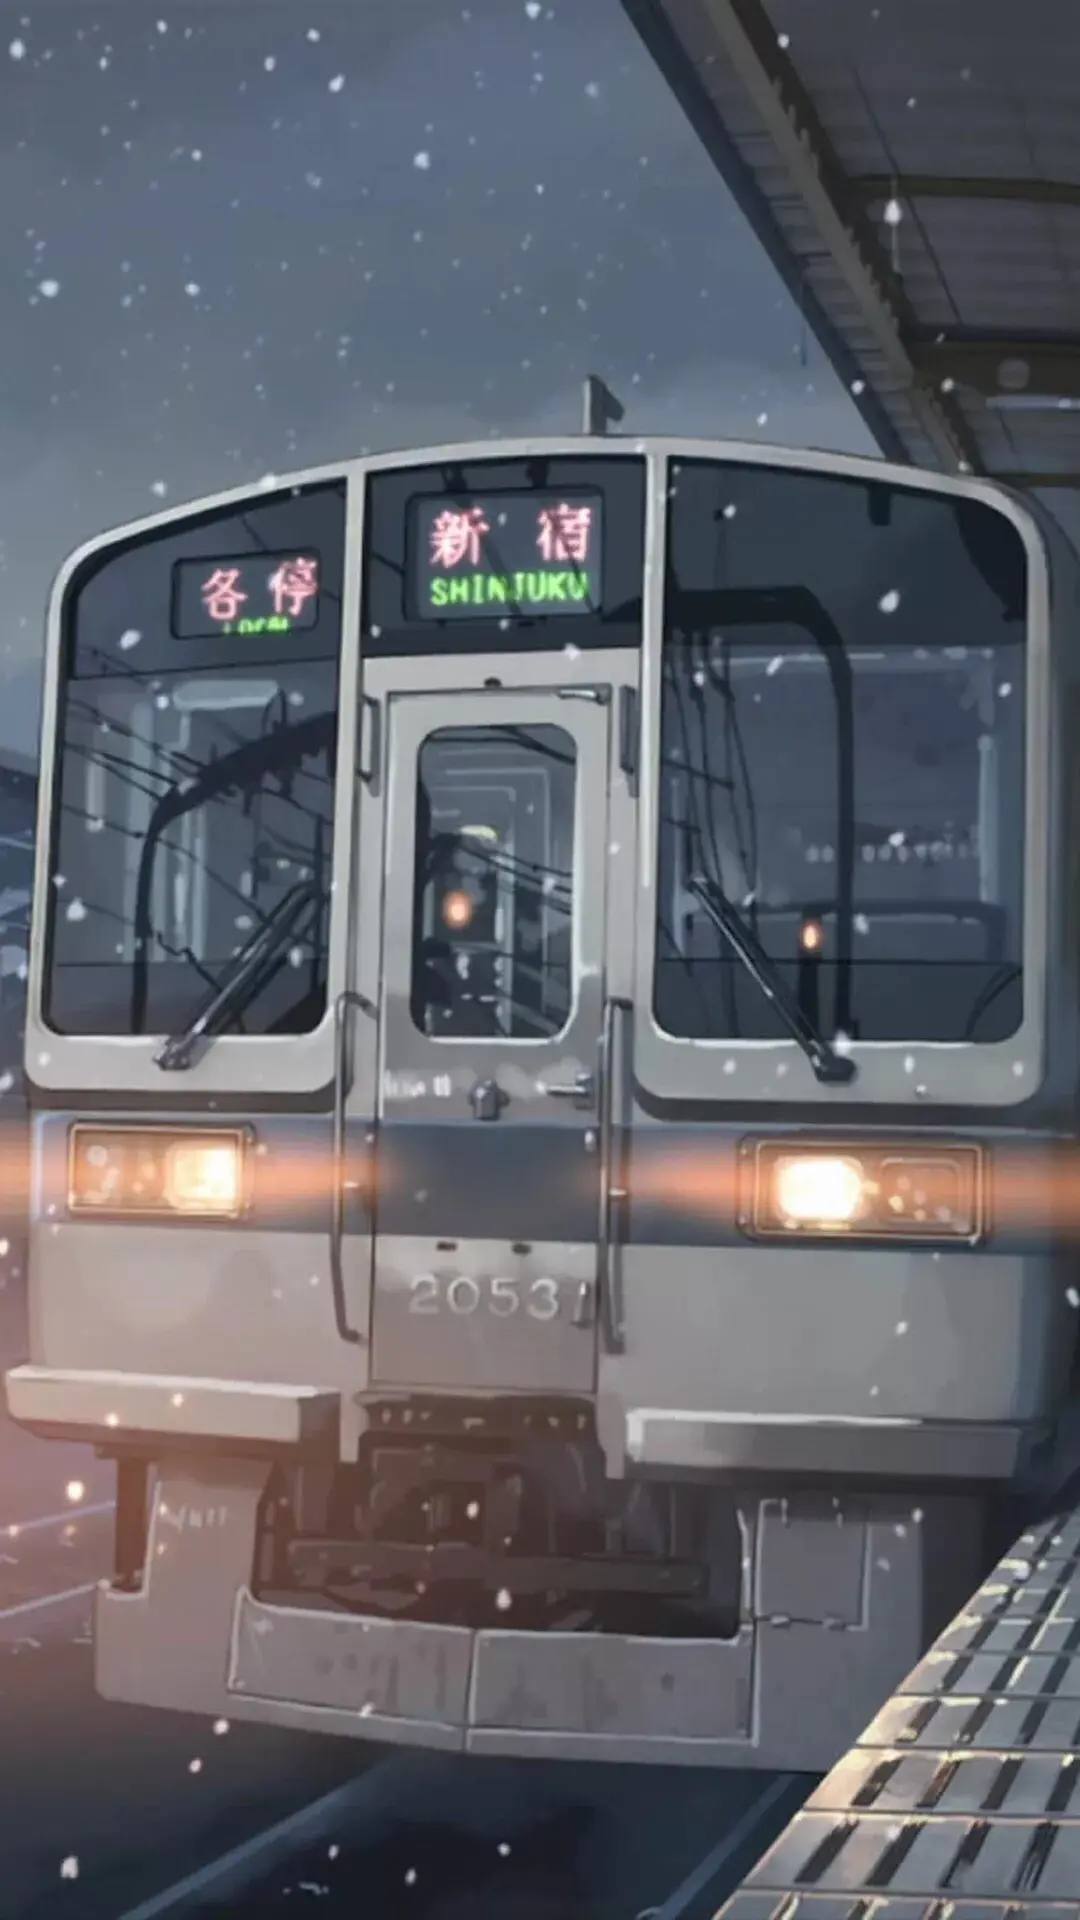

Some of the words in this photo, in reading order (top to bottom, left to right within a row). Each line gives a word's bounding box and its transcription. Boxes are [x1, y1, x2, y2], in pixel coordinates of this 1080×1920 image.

[430, 503, 592, 568] 新宿
[201, 558, 318, 619] 各停
[430, 572, 588, 605] SHINJUKU
